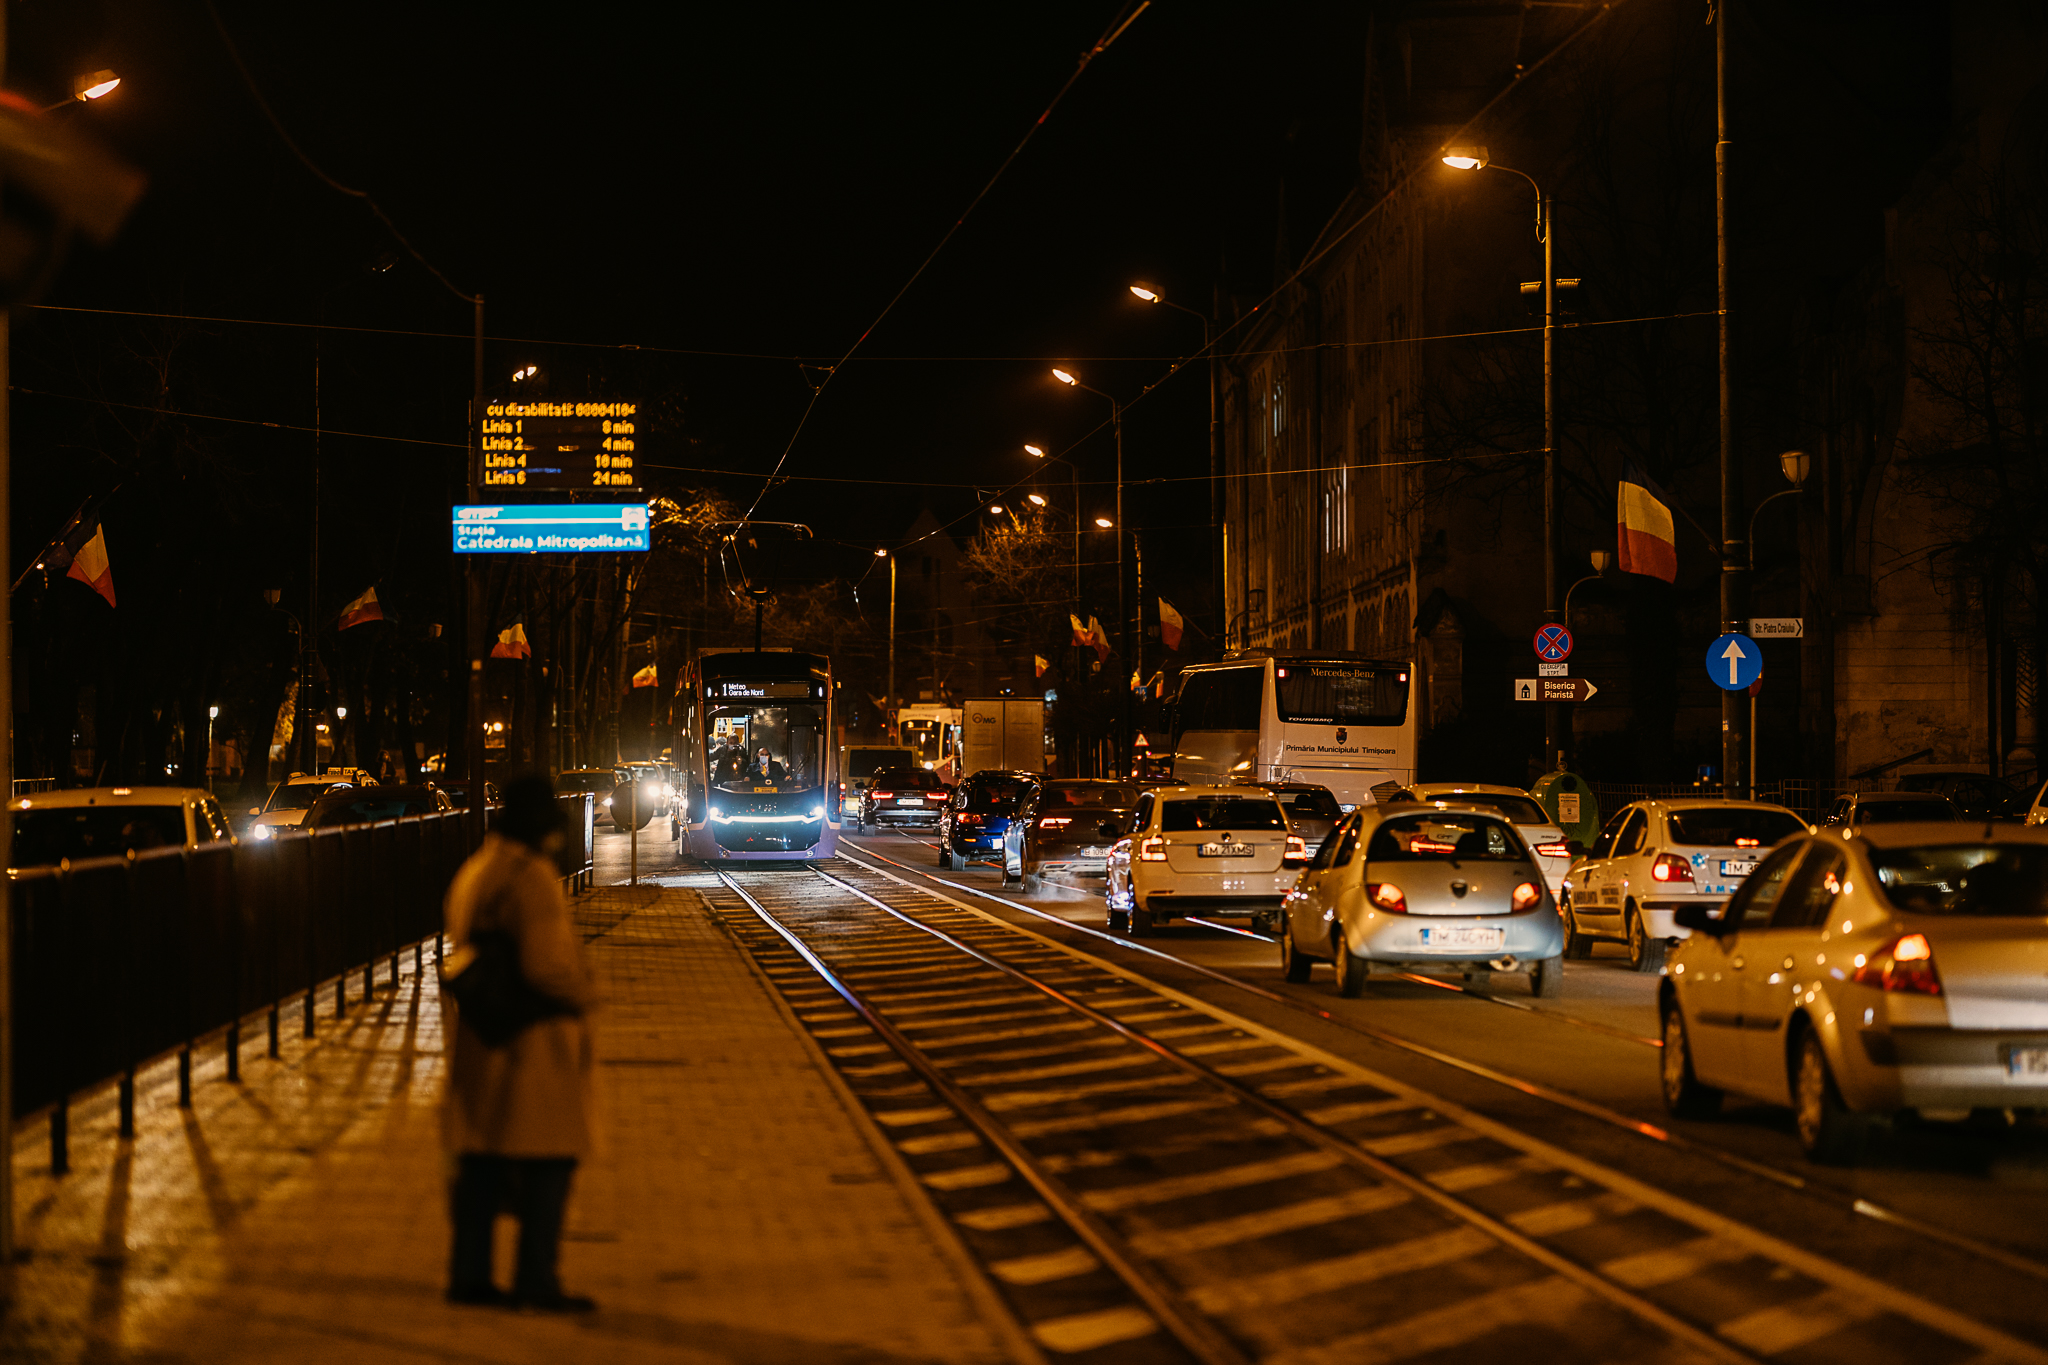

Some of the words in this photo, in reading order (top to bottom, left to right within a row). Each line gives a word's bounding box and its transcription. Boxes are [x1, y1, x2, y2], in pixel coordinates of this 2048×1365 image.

[486, 404, 504, 417] cu
[482, 419, 513, 434] Linia
[515, 419, 523, 434] 1
[602, 420, 612, 434] 8
[612, 420, 635, 434] min
[482, 436, 513, 451] Linia
[513, 436, 524, 451] 2
[602, 437, 612, 451] 4
[612, 437, 635, 451] min
[485, 453, 516, 468] Linia
[517, 453, 527, 468] 4
[594, 453, 611, 468] 10
[611, 454, 633, 468] min
[485, 470, 516, 485] Linia
[517, 470, 527, 485] 6
[592, 471, 610, 485] 24
[611, 471, 633, 485] min
[457, 535, 534, 549] Catedrala
[1755, 623, 1763, 633] Str.
[1764, 623, 1777, 633] Piatra
[1778, 623, 1795, 633] Craiului
[1310, 668, 1375, 679] Mercedes-Benz
[722, 683, 728, 696] 1
[1544, 681, 1576, 690] Biserica
[728, 689, 743, 697] Gara
[750, 689, 765, 697] Nord
[1544, 690, 1574, 699] Piaristă
[1286, 744, 1315, 752] Primăria
[1317, 745, 1359, 755] Municipiului
[1362, 746, 1396, 755] Timișoara
[1084, 848, 1090, 856] B
[1093, 848, 1110, 856] 109C
[1203, 845, 1218, 856] TM
[1221, 844, 1253, 855] 21XMS
[1727, 863, 1743, 874] TM
[1431, 932, 1449, 943] TM
